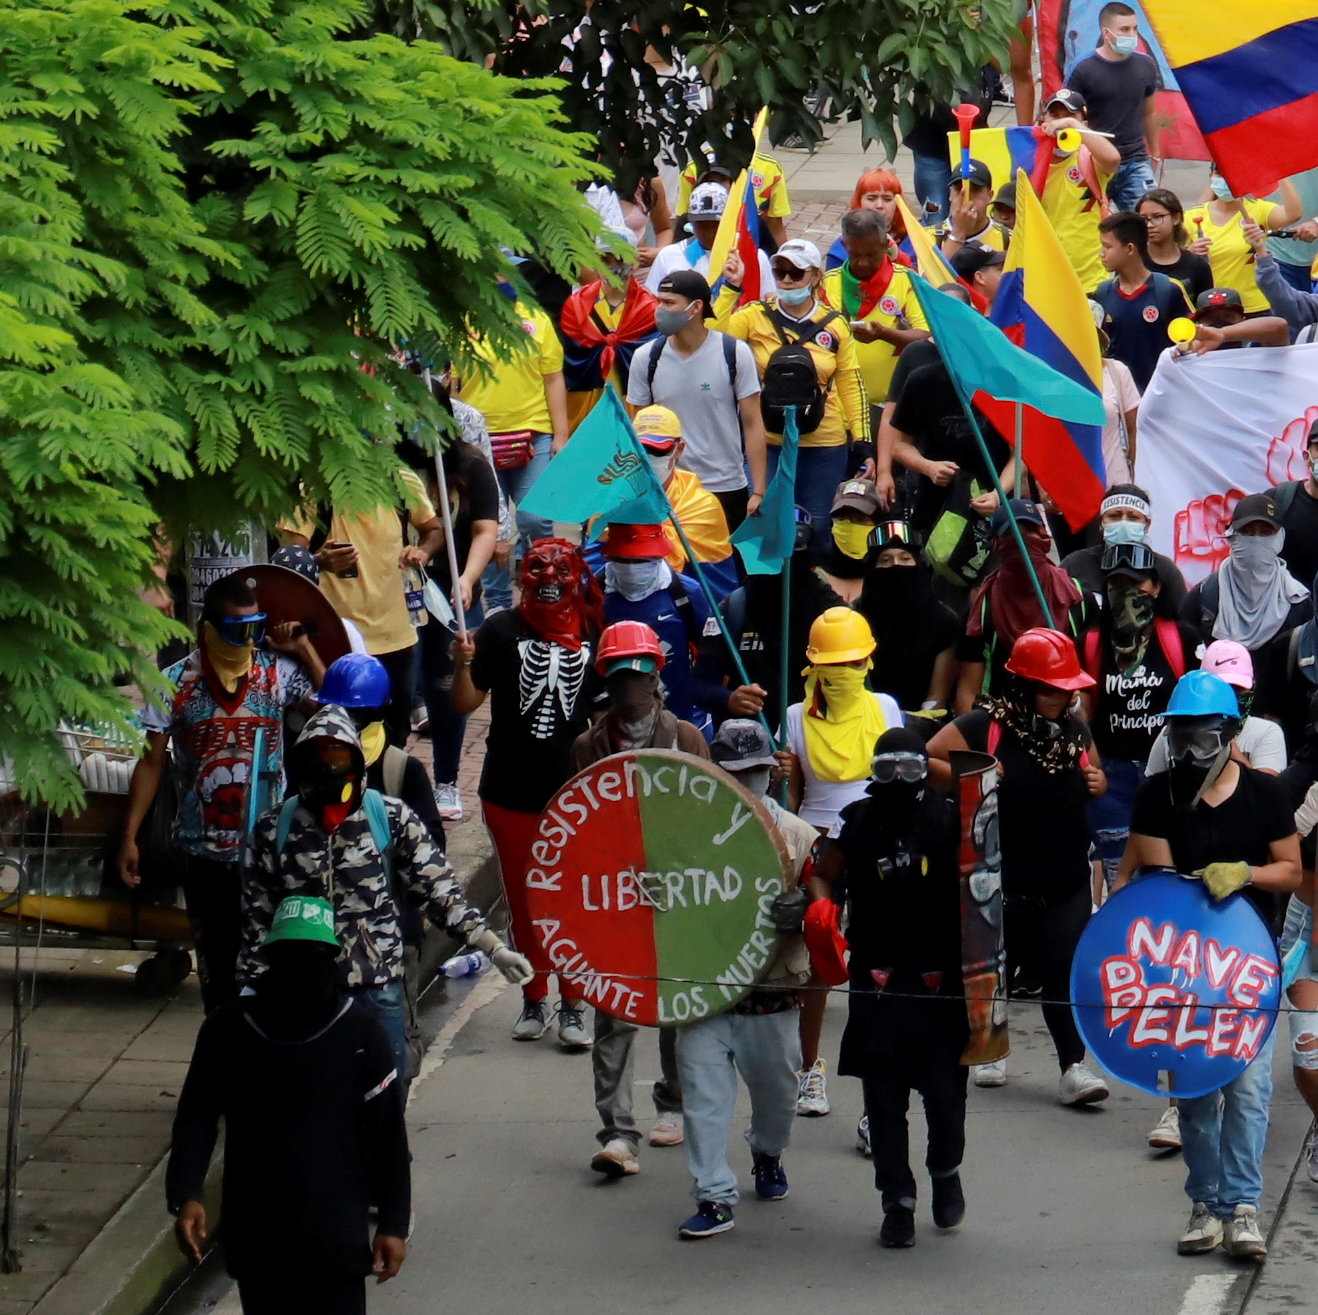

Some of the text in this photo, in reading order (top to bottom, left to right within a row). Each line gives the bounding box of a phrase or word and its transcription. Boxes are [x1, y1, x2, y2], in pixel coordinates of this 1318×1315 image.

[1105, 671, 1163, 697] Mamá
[1127, 690, 1151, 711] del
[581, 865, 743, 912] LIBERTAD
[656, 985, 709, 1024] LOS
[714, 876, 784, 1002] MUERTOS
[1127, 917, 1280, 1010] NAVE
[1100, 954, 1269, 1061] BELEN
